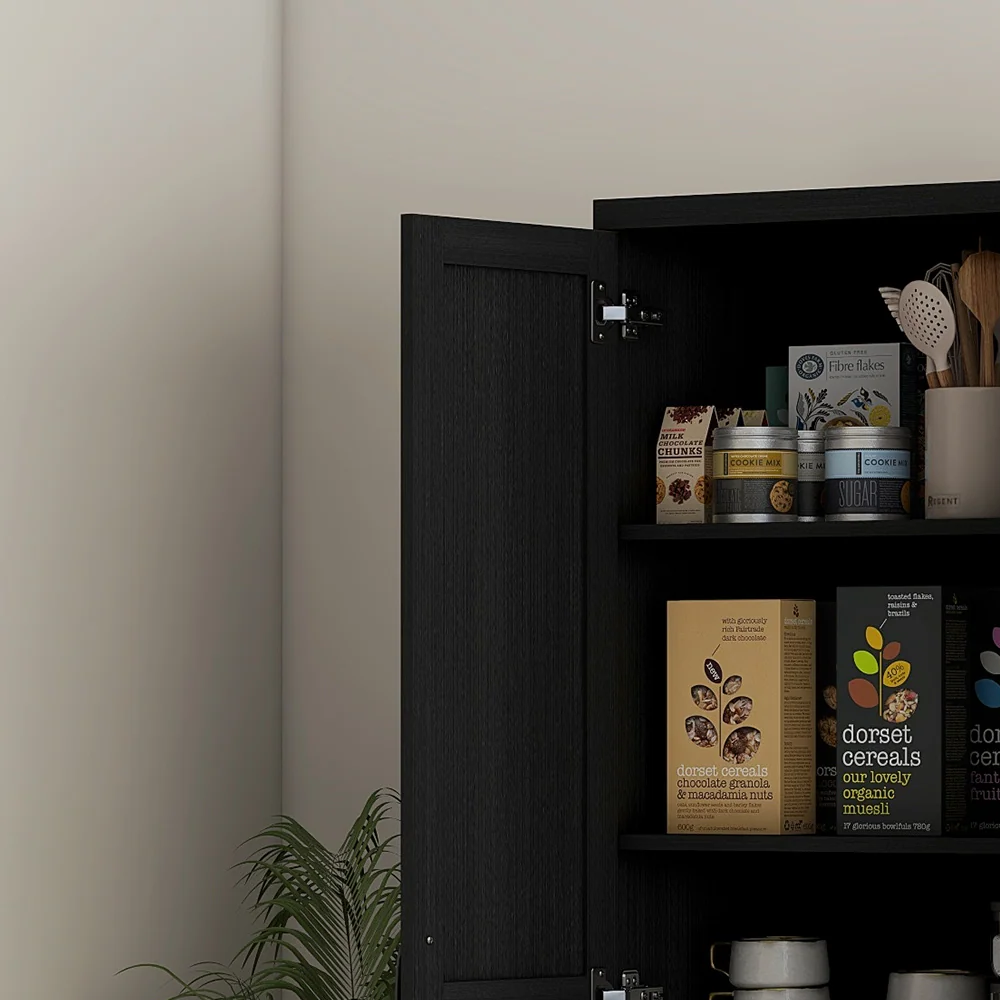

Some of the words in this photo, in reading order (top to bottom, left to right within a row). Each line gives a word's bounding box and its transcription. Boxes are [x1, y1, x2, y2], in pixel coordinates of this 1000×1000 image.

[828, 360, 854, 372] Fibre
[856, 359, 885, 371] flakes
[658, 447, 702, 456] CHUNKS
[766, 459, 781, 467] MIX
[797, 462, 814, 470] KIE
[864, 458, 897, 466] COOKIE
[840, 480, 878, 508] SUGAR
[928, 495, 958, 508] REGENT
[912, 592, 934, 600] flakes,
[737, 617, 768, 626] gloriously
[722, 634, 736, 642] dark
[738, 634, 767, 642] chocolate
[706, 661, 720, 682] new
[886, 664, 905, 680] 40%
[842, 724, 912, 744] dorset
[842, 747, 921, 766] cereals
[676, 764, 718, 776] dorset
[721, 764, 768, 776] cereals
[676, 778, 726, 788] chocolate
[728, 778, 770, 790] granola
[842, 773, 868, 783] our
[870, 771, 912, 786] lovely
[676, 790, 687, 800] &
[688, 790, 748, 800] macadamia
[750, 790, 774, 800] nuts
[842, 787, 895, 801] organic
[842, 802, 890, 815] muesli
[843, 822, 850, 830] 17
[852, 822, 881, 831] glorious
[882, 822, 912, 830] bowlfuls
